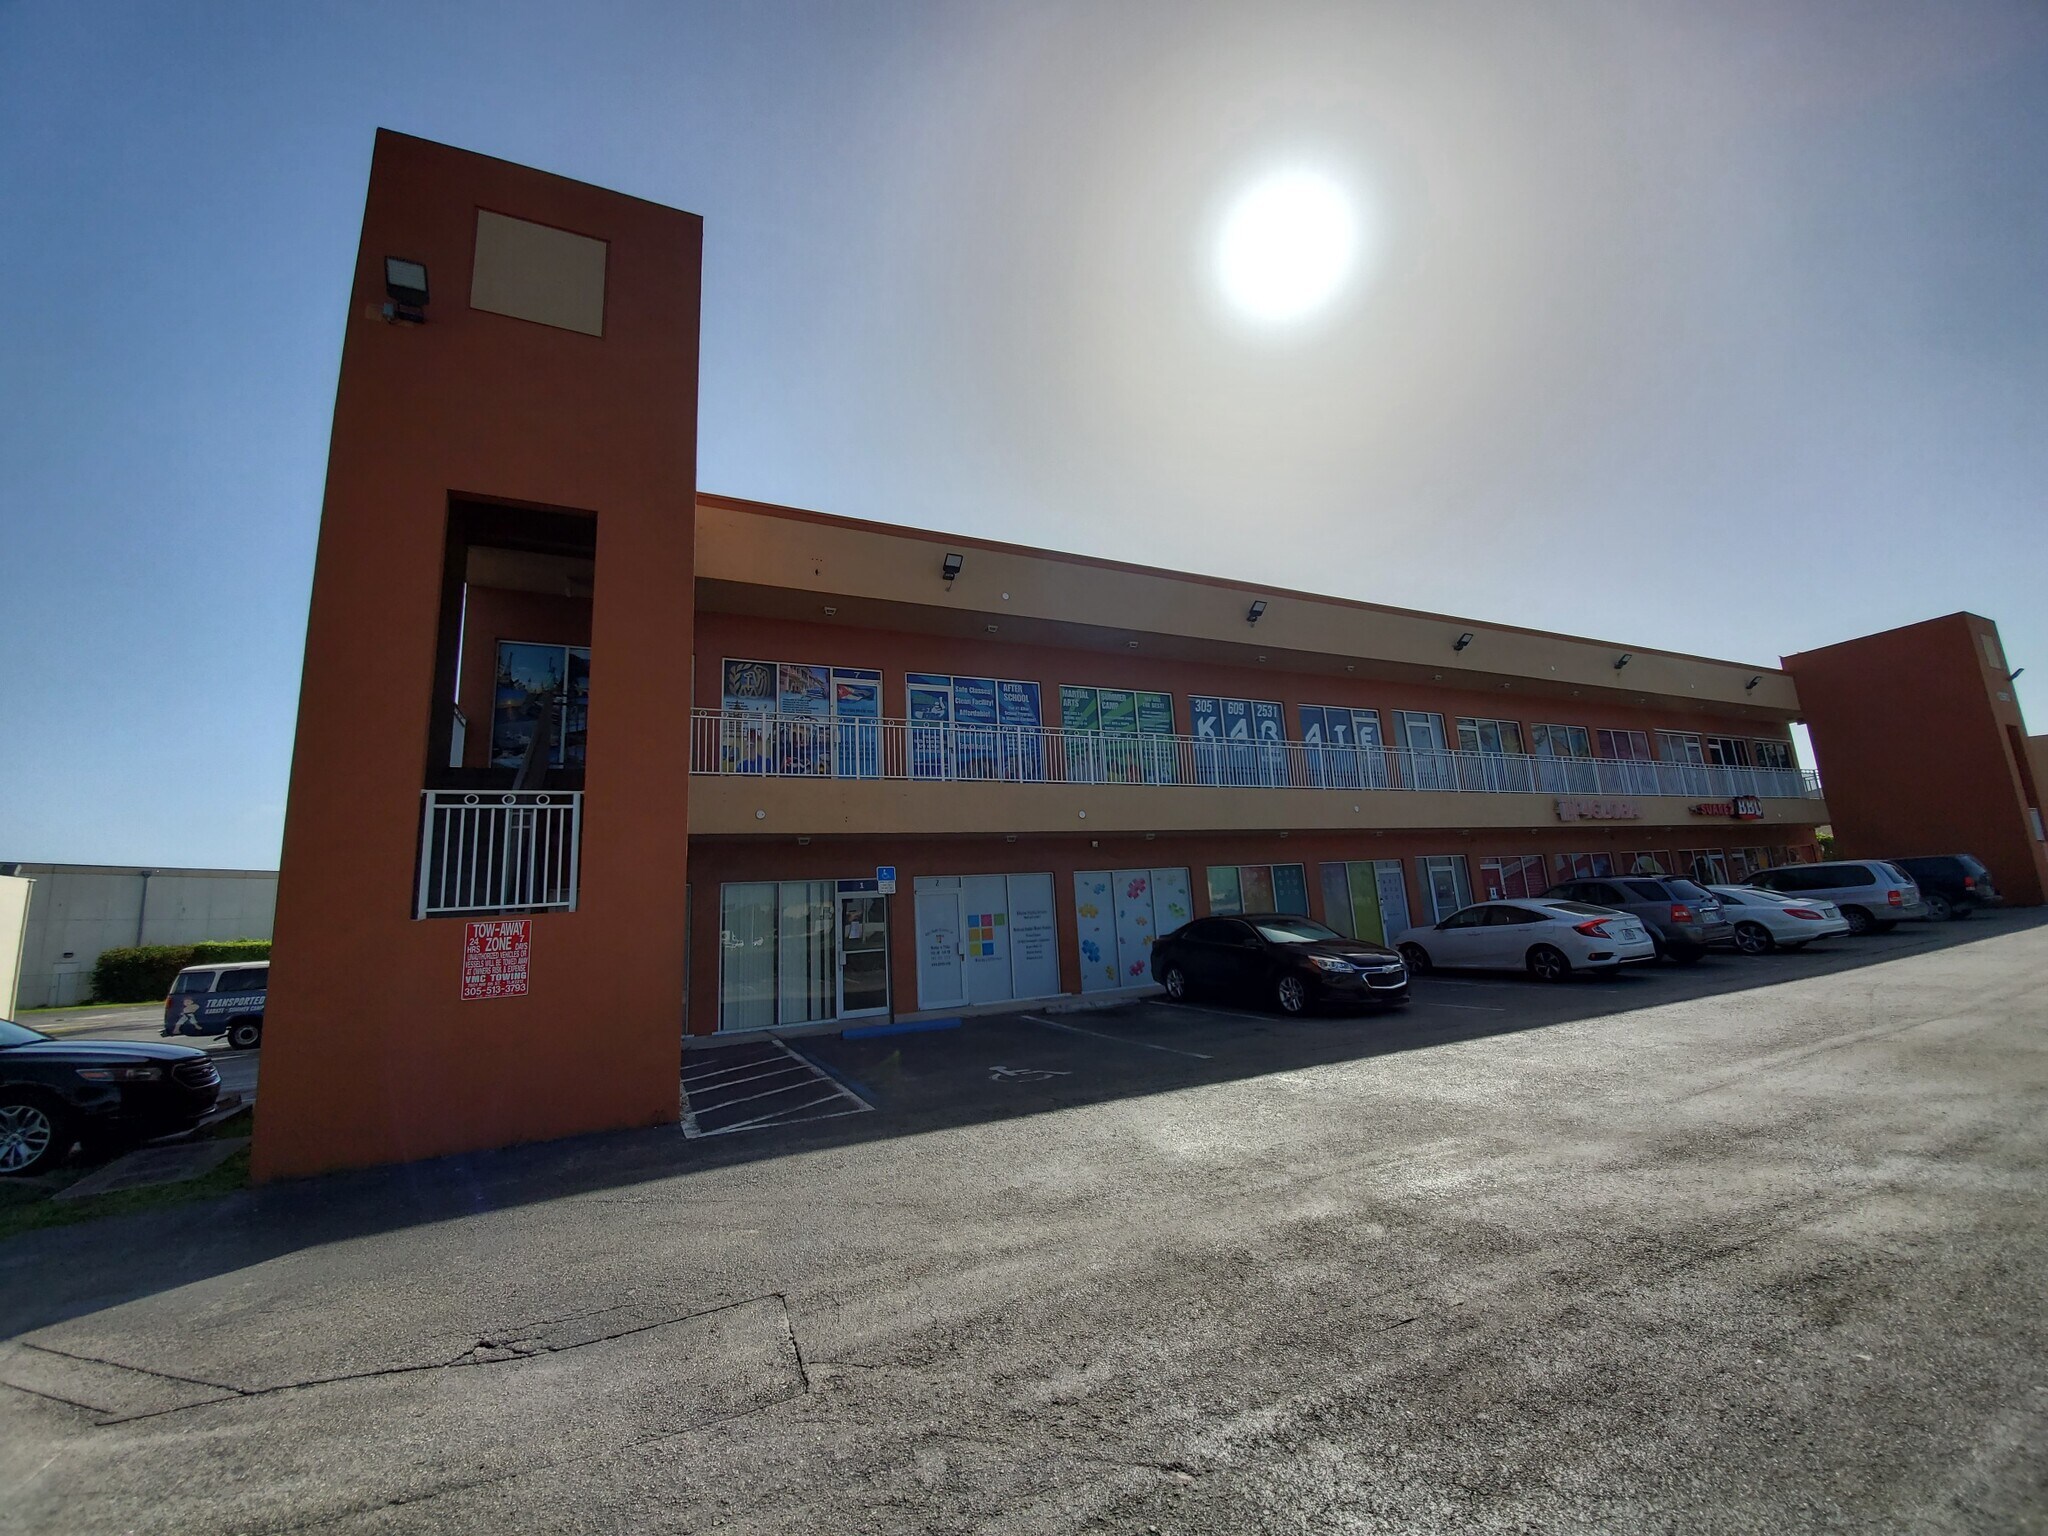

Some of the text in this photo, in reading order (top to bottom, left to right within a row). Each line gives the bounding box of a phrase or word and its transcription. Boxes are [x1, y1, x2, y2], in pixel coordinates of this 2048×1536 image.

[1003, 684, 1023, 693] AFTER
[1003, 693, 1030, 703] SCHOOL
[1062, 689, 1089, 699] MARTIAL
[1101, 693, 1126, 702] SUMMER
[972, 699, 994, 707] Facility!
[1063, 698, 1080, 707] ARTS
[1101, 702, 1119, 710] CAMP
[959, 709, 991, 718] Affordable!
[1195, 700, 1278, 718] 305 609 2531
[473, 922, 525, 938] TOW-AWAY
[469, 938, 479, 946] 24
[485, 937, 512, 952] ZONE
[515, 942, 528, 950] DAYS
[465, 972, 527, 983] VMC TOWING
[464, 984, 526, 995] 305-513-3793
[206, 996, 266, 1007] TRANSPORTED
